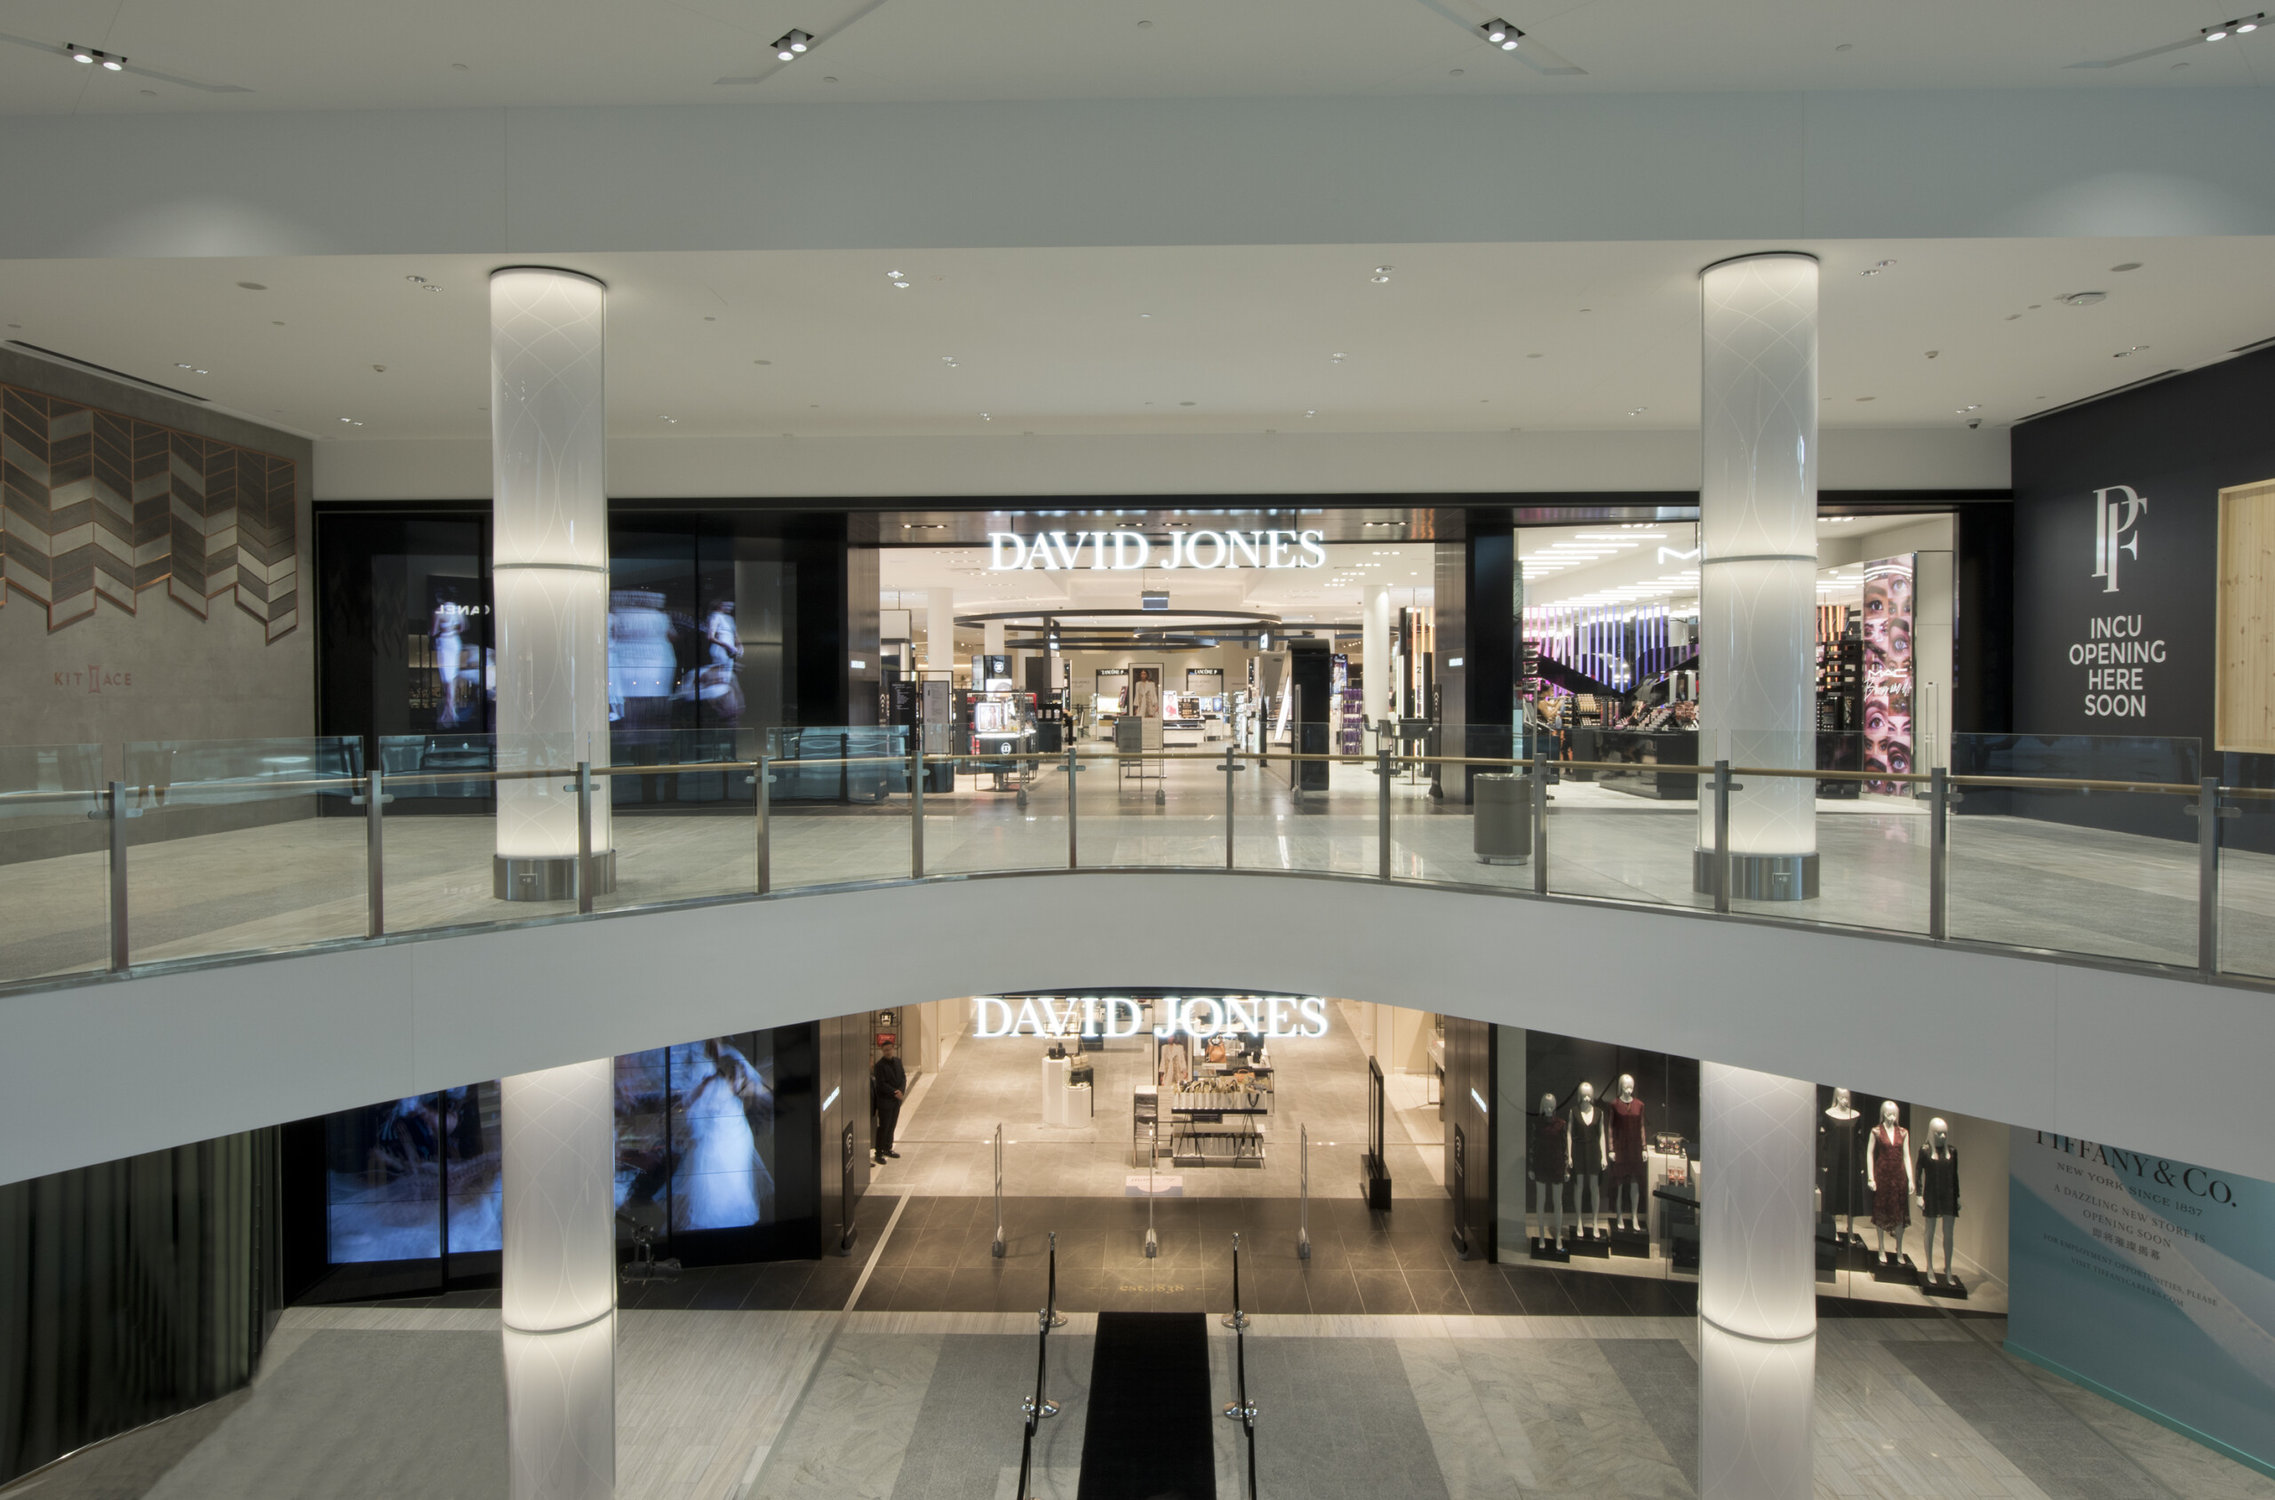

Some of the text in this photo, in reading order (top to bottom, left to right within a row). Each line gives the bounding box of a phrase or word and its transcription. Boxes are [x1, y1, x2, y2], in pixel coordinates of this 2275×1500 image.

[987, 529, 1327, 570] DAVID JONES
[2090, 614, 2142, 640] INCU
[2068, 639, 2167, 668] OPENING
[53, 671, 132, 686] KIT ACE
[2088, 667, 2144, 691] HERE
[2084, 692, 2146, 719] SOON
[972, 996, 1328, 1039] DAVID JONES
[2057, 1162, 2204, 1217] NEW YORK SINCE 1837
[2153, 1160, 2176, 1188] &
[2054, 1183, 2207, 1244] A DAZZLING NEW STORE IS
[2083, 1209, 2171, 1249] OPENING SOON
[2060, 1239, 2113, 1265] EMPLOYMENT
[2186, 1289, 2217, 1308] PLEASE
